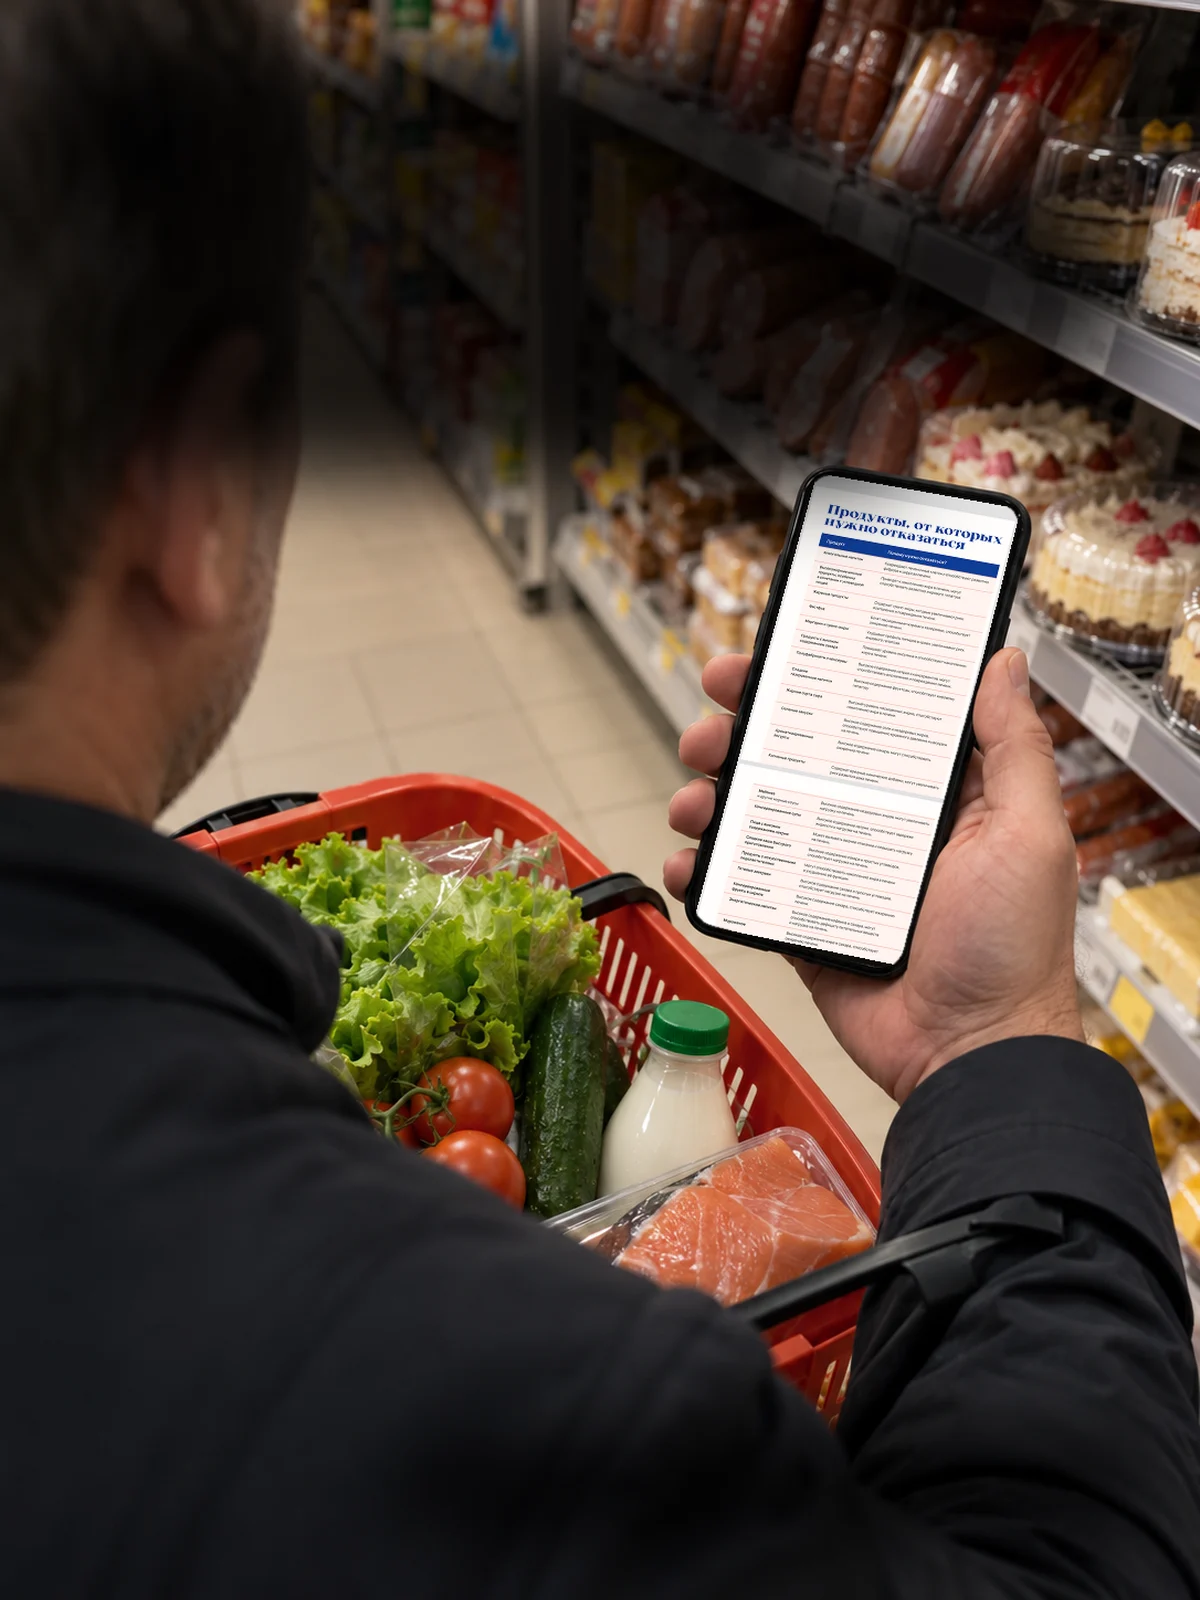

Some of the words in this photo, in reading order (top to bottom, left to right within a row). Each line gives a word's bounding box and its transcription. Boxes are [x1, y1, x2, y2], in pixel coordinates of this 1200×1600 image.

[824, 517, 878, 534] нужно
[880, 527, 965, 550] отказаться
[913, 521, 932, 532] от
[935, 525, 1003, 544] которых
